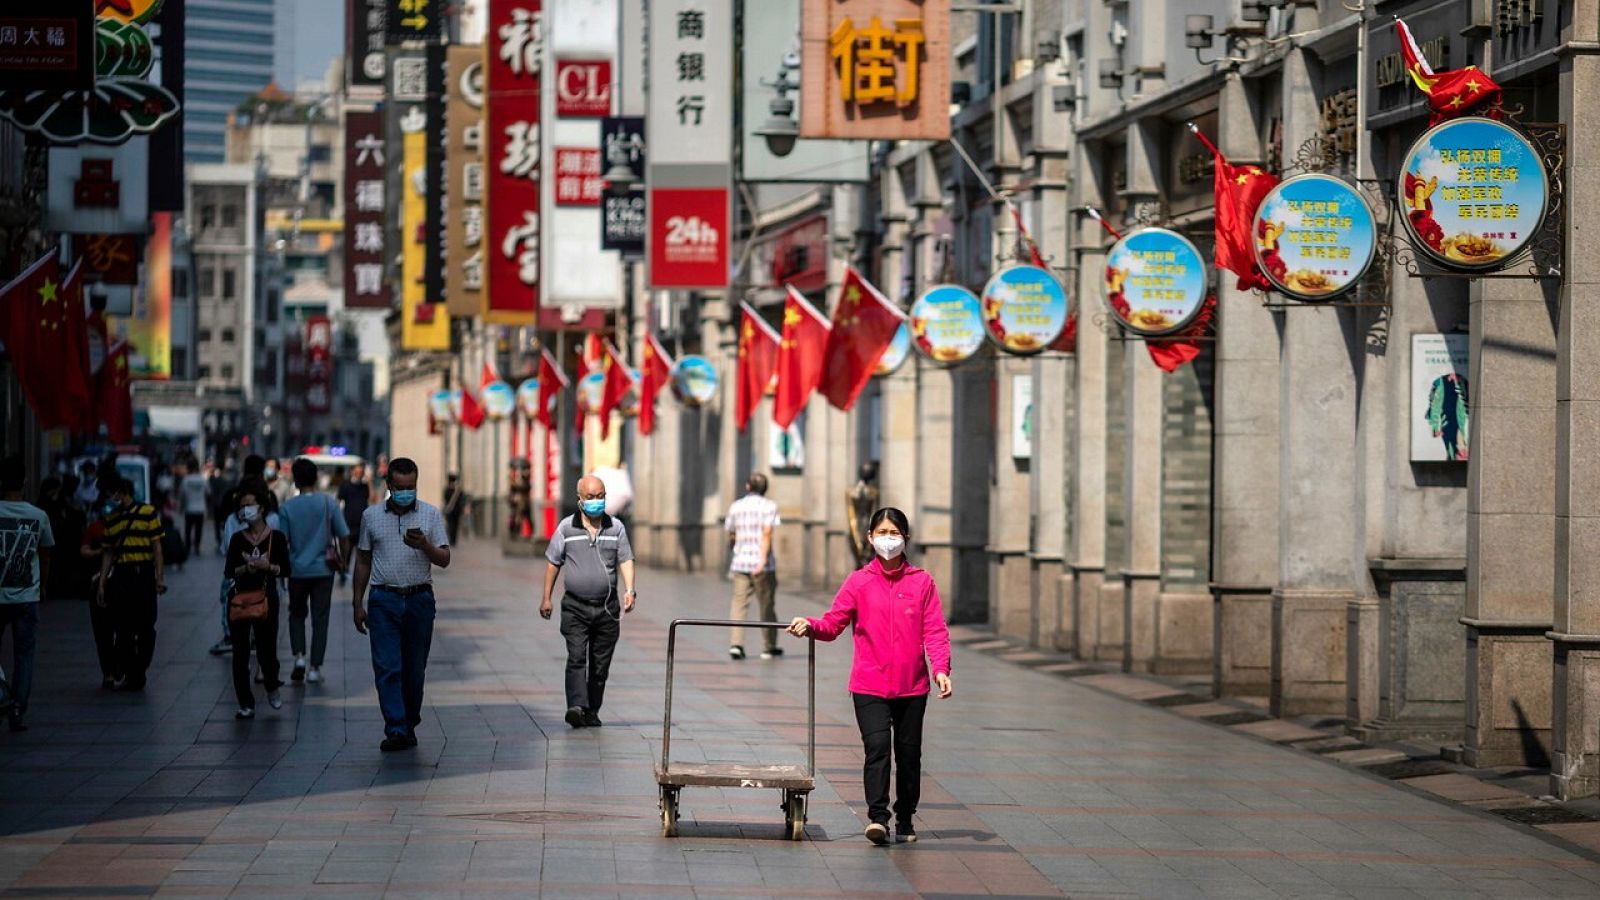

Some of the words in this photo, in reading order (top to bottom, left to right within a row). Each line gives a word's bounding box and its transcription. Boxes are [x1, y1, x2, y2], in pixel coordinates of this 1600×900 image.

[0, 26, 65, 47] 周大福
[677, 10, 704, 125] 商银行
[831, 16, 925, 107] 街
[559, 64, 610, 103] CL
[354, 134, 385, 295] 六福珠寶
[665, 215, 718, 245] 24h
